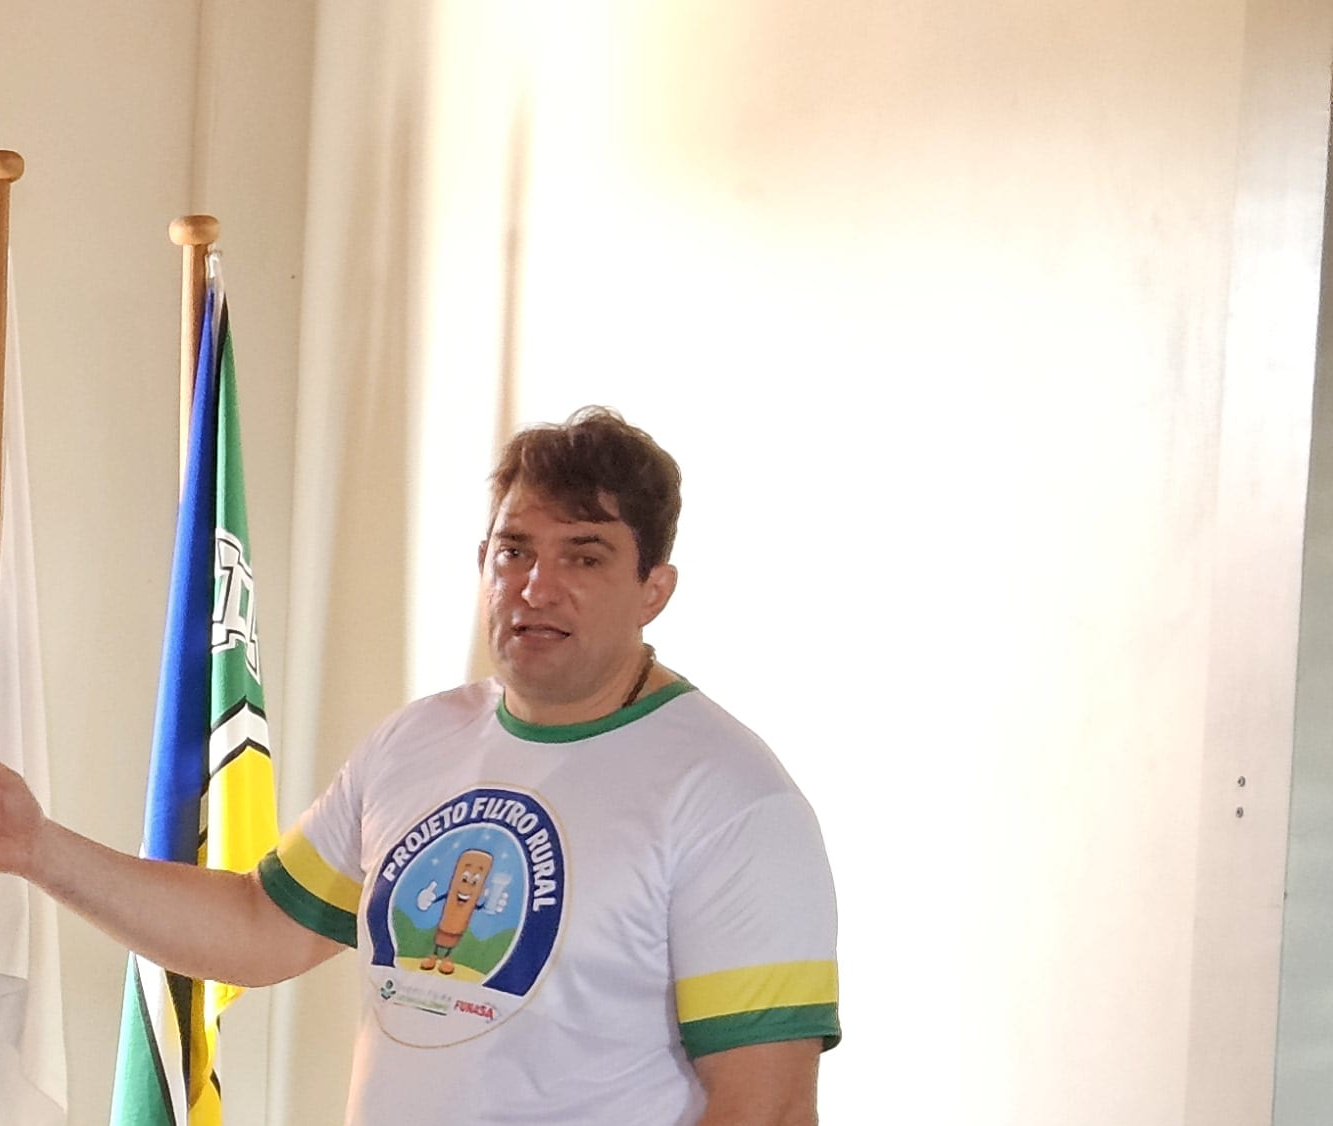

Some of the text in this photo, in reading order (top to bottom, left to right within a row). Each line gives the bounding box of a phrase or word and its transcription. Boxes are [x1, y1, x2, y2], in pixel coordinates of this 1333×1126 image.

[383, 797, 556, 912] PROJETO FILTRO RURAL
